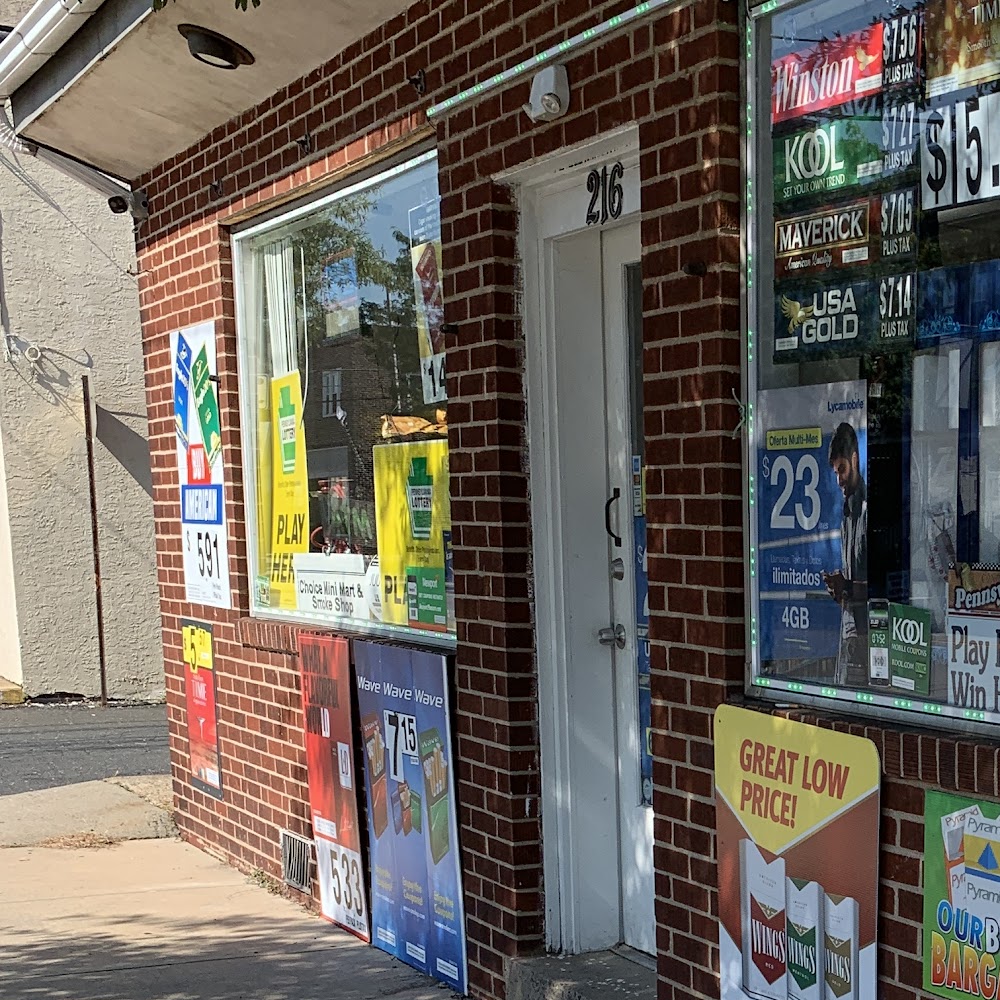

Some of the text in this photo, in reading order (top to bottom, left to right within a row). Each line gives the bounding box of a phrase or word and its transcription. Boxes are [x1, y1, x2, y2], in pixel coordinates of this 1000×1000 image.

[883, 15, 917, 64] $7.56
[775, 56, 854, 114] Winston
[884, 62, 914, 84] PLUS TAX
[785, 125, 845, 184] KOOL
[884, 148, 913, 170] PLUS TAX
[586, 162, 624, 225] 216
[826, 173, 846, 188] TREND
[779, 210, 864, 252] MAVERICK
[882, 236, 911, 256] PLUS TAX
[813, 287, 857, 317] USA
[880, 275, 911, 319] $7.14
[801, 313, 859, 344] GOLD
[881, 319, 910, 338] PLUS TAX
[769, 436, 787, 446] Oferta
[411, 497, 431, 509] LOTTERY
[762, 454, 821, 531] $ 23
[277, 514, 305, 545] PLAY
[197, 532, 220, 579] 591
[299, 580, 364, 599] Choice Mini Mart &
[772, 567, 821, 586] ilimitados
[312, 596, 354, 615] Smoke Shop
[781, 606, 810, 629] 4GB
[892, 616, 928, 646] KOOL
[951, 625, 989, 675] Play
[357, 676, 381, 693] Wave
[383, 682, 412, 700] Wave
[414, 688, 443, 708] Wave
[951, 670, 987, 710] Win
[739, 739, 850, 800] GREAT LOW
[740, 779, 799, 829] PRICE!
[945, 807, 979, 828] Pyramid
[330, 849, 363, 916] 533
[752, 918, 785, 964] WINGS
[788, 936, 816, 975] WINGS
[825, 948, 850, 984] WINGS
